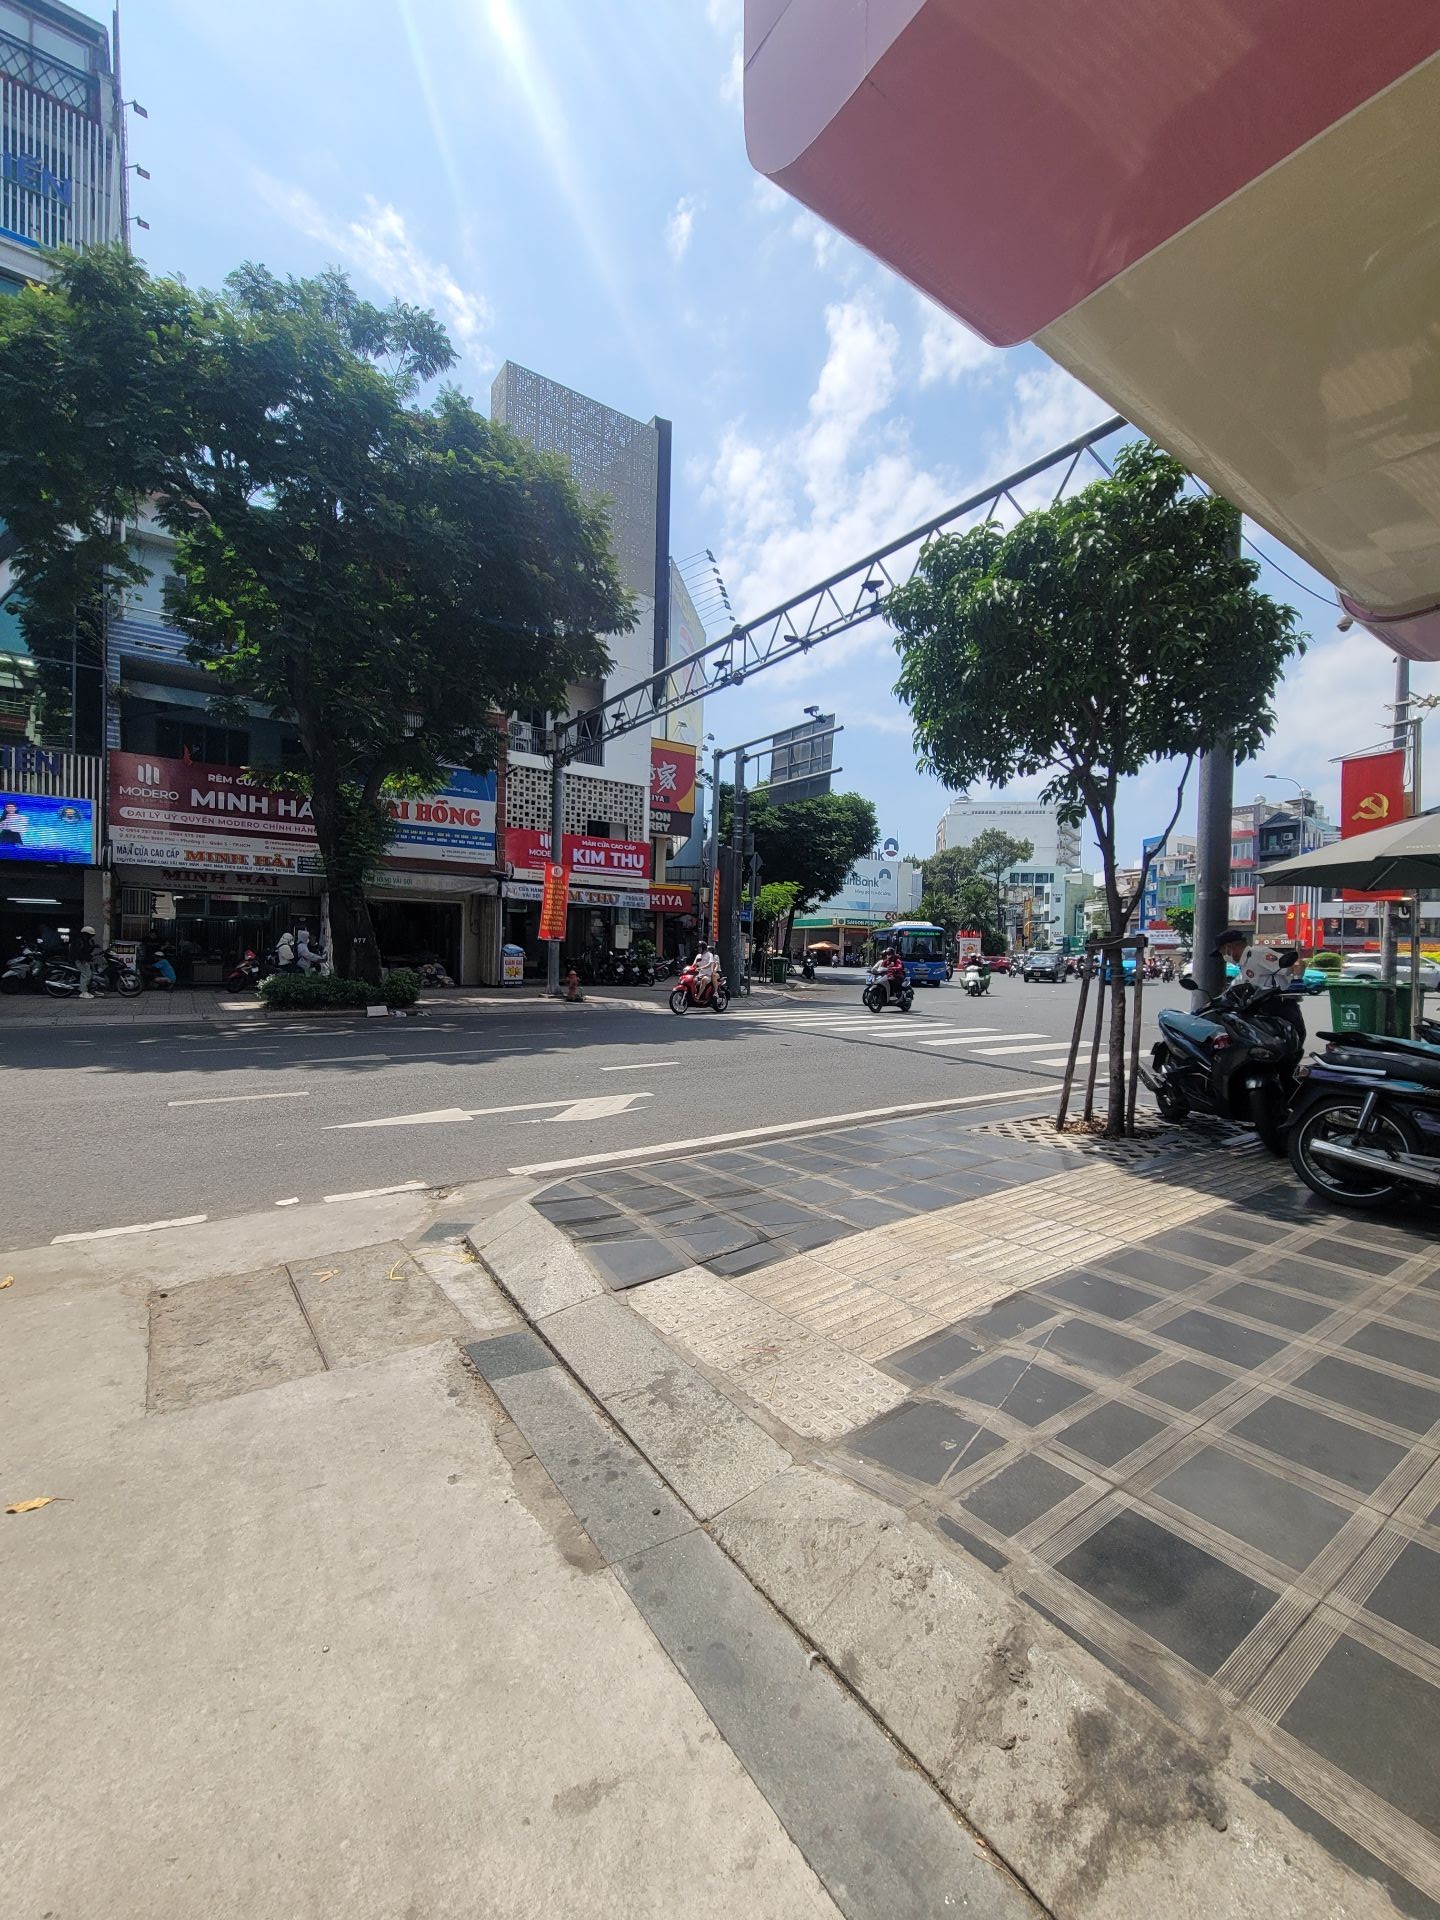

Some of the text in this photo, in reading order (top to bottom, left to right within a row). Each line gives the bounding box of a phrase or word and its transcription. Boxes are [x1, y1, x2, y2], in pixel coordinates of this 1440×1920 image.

[119, 785, 180, 801] MODERO
[651, 794, 665, 803] IYA
[191, 788, 269, 815] MINH
[278, 794, 315, 821] HẢ
[219, 817, 260, 829] MODERO
[263, 820, 293, 833] CHÍNH
[150, 848, 164, 858] CAO
[184, 850, 249, 865] MINH
[528, 848, 552, 858] MODE
[573, 848, 645, 869] KIM THU
[161, 869, 226, 883] MINH
[651, 894, 683, 907] KIYA
